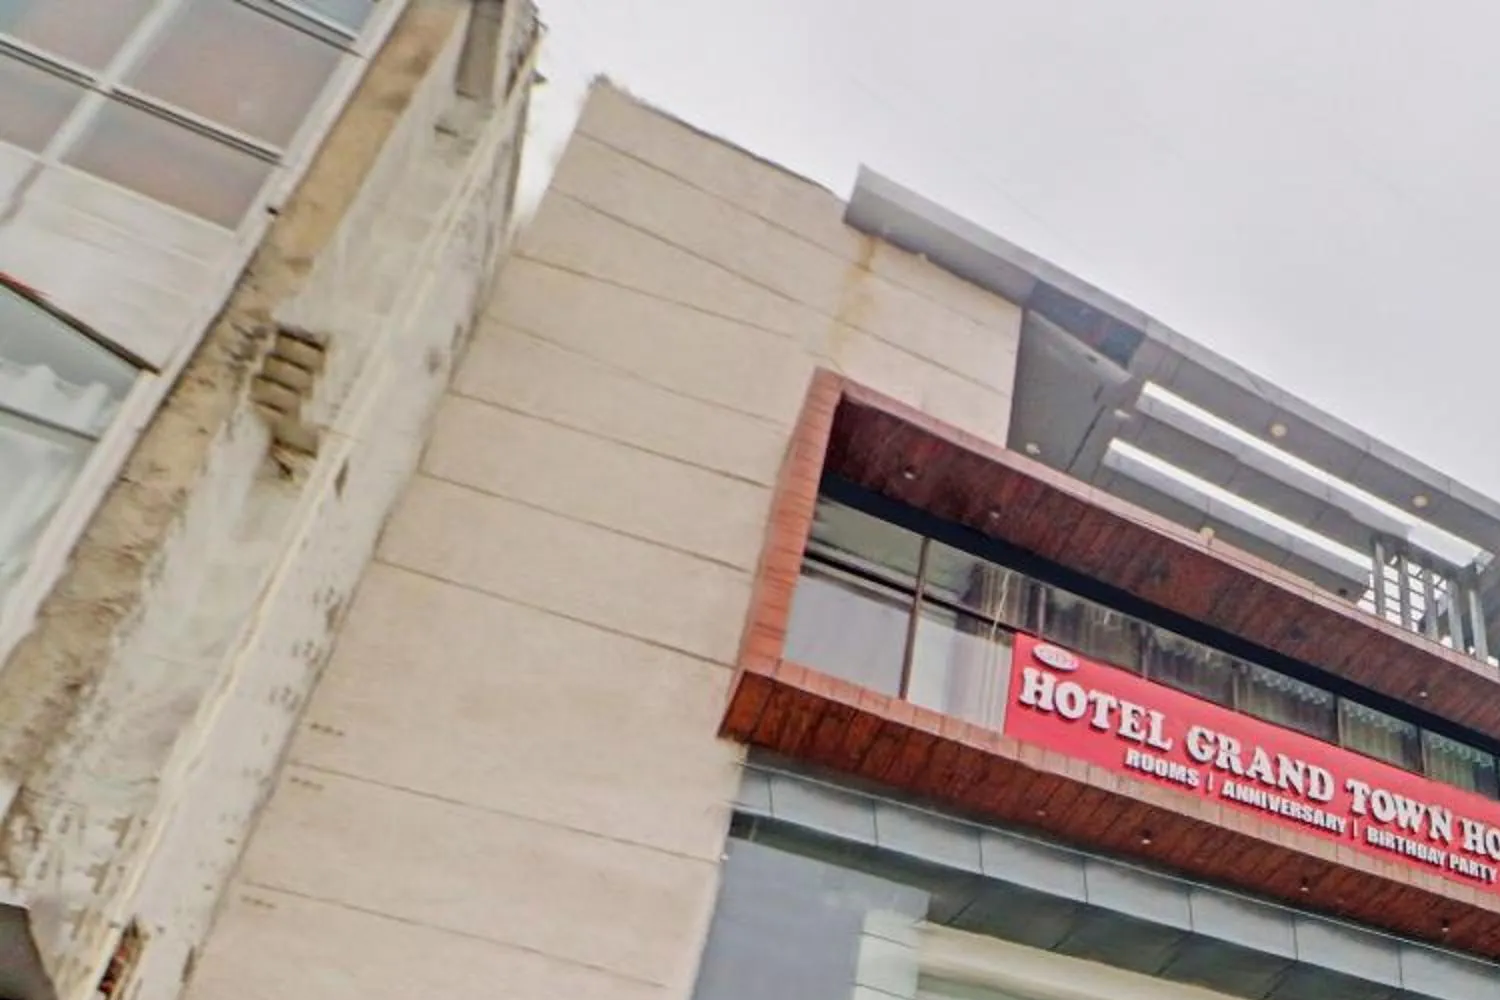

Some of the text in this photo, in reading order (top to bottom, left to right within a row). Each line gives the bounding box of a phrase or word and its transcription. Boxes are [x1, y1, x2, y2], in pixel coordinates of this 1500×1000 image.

[1019, 667, 1173, 751] HOTEL
[1186, 724, 1334, 802] GRAND
[1346, 778, 1453, 844] TOWN
[1125, 748, 1497, 884] ROOMS ANNIVERSARY BIRTHDAY PARTY
